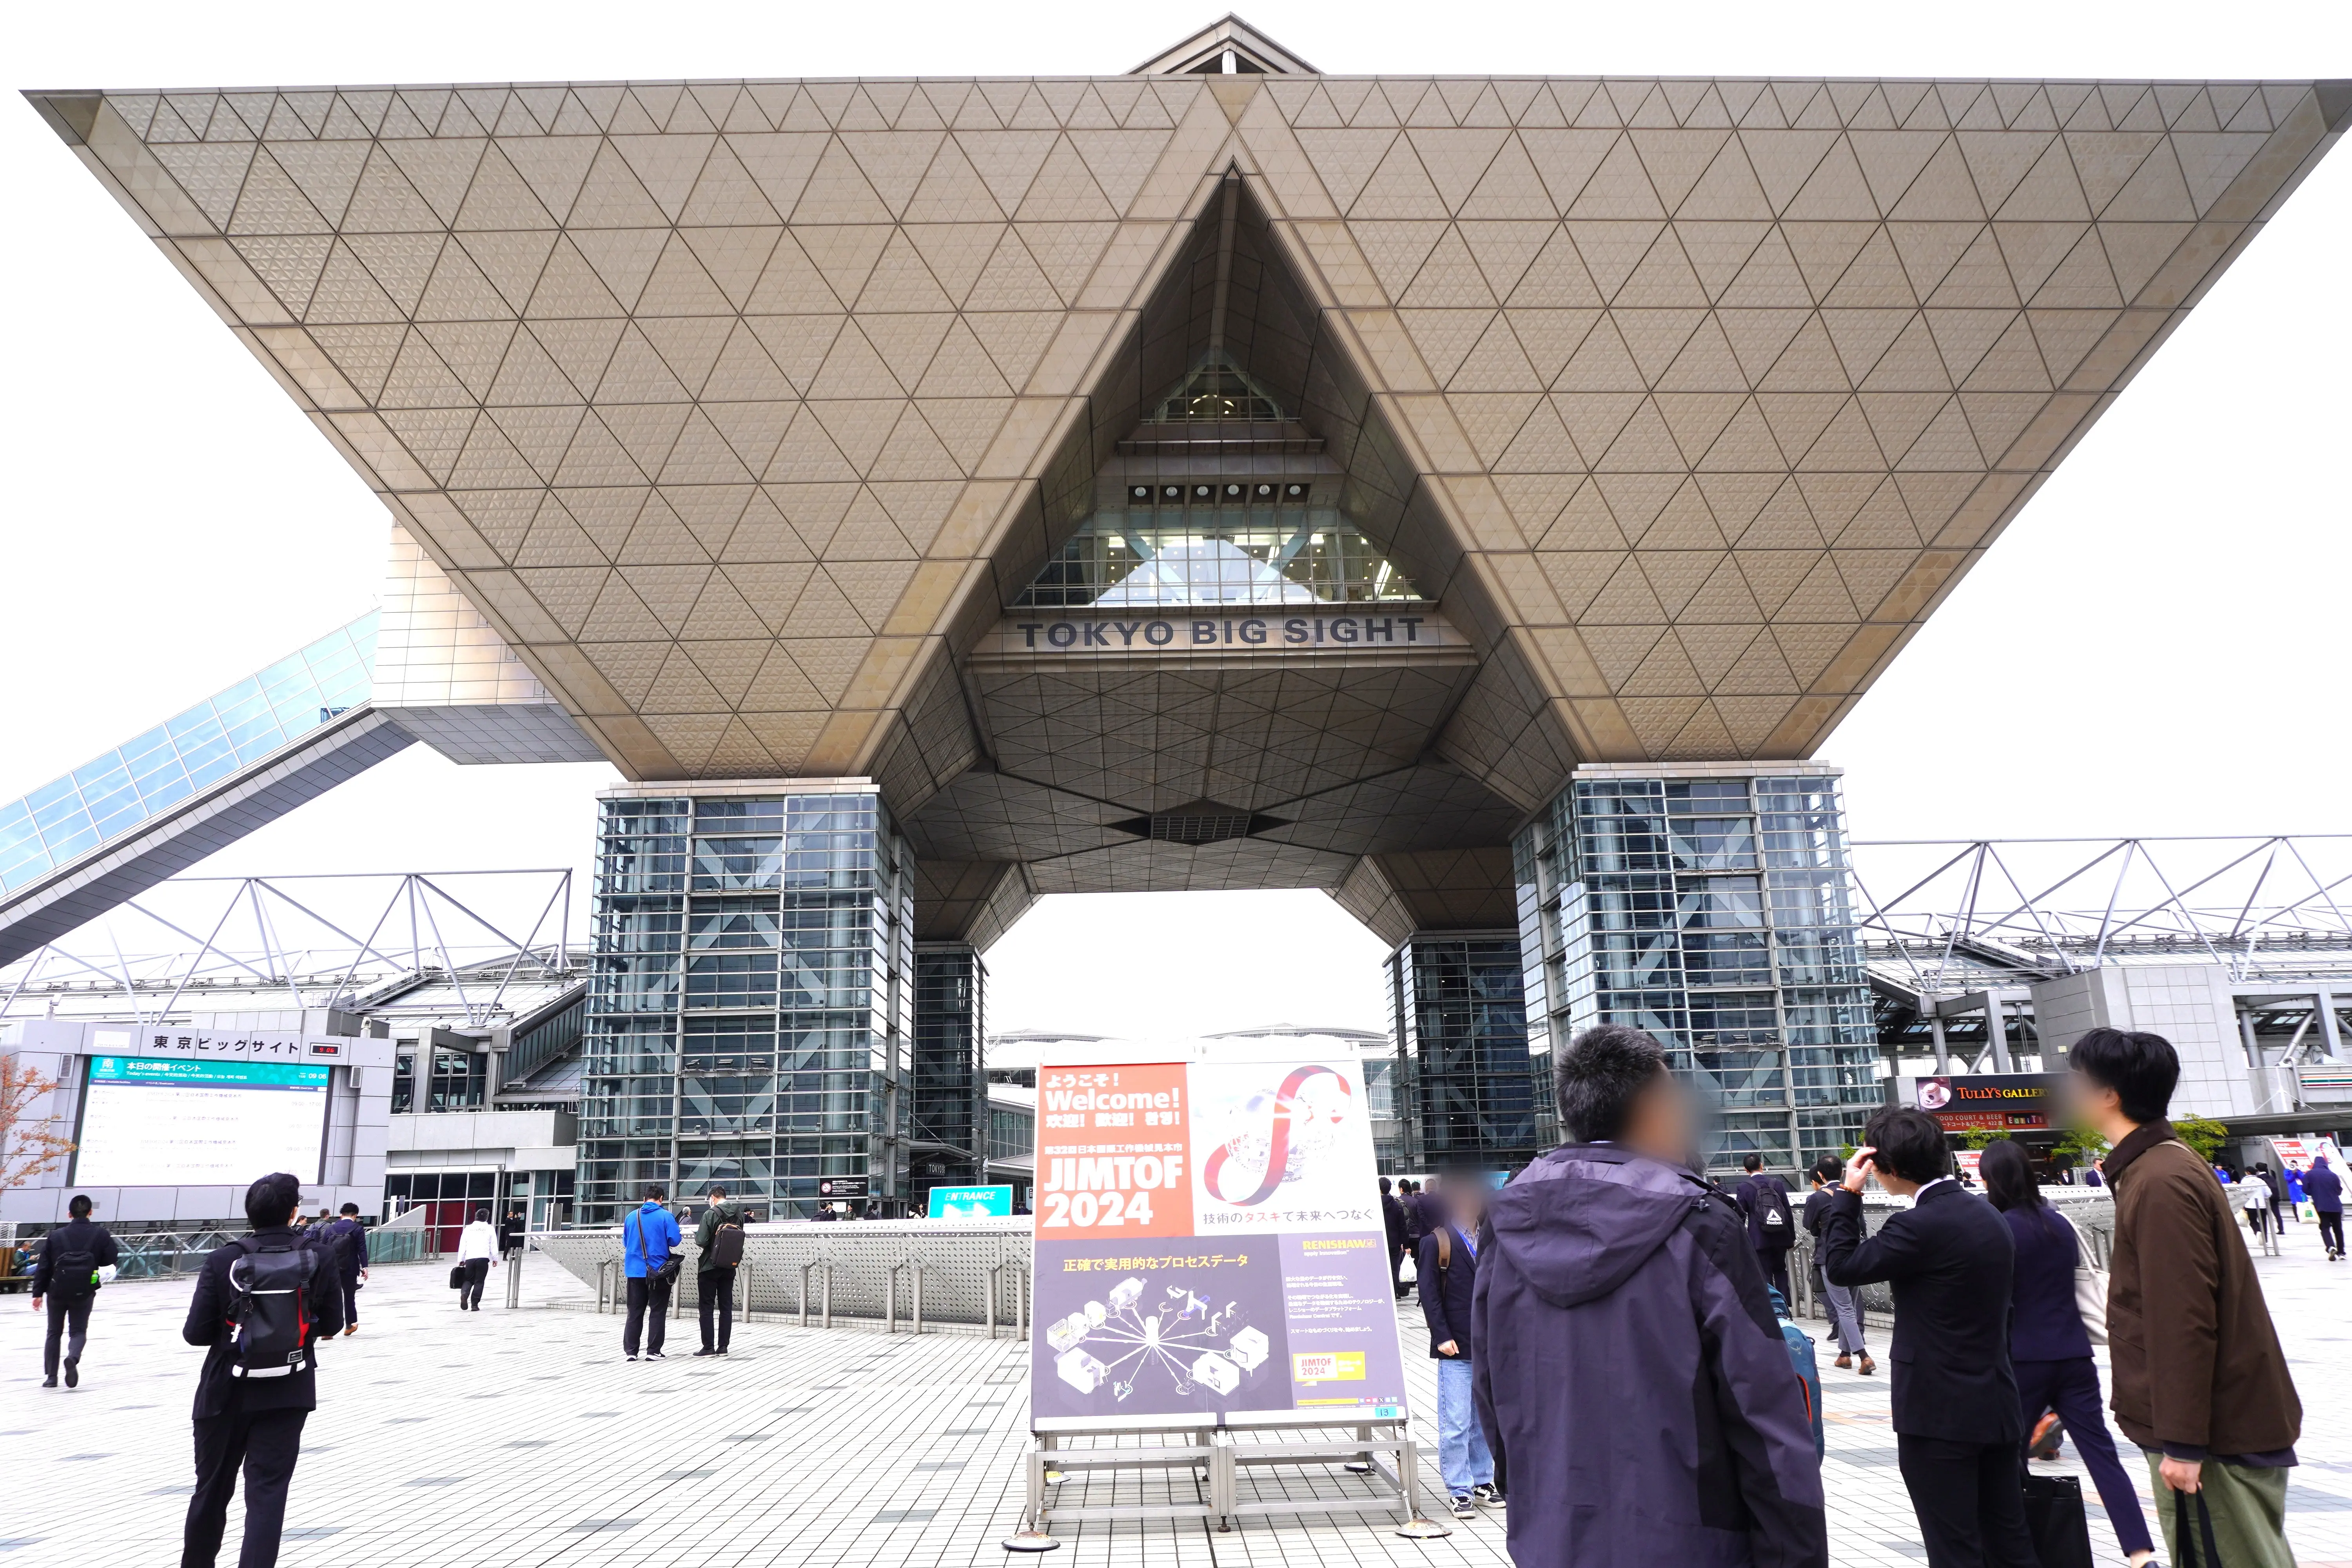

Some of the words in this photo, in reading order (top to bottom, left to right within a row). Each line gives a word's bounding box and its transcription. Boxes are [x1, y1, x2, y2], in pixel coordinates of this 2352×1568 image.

[1017, 621, 1173, 647] TOKYO
[1192, 619, 1267, 644] BIG
[1285, 617, 1424, 643] SIGHT
[153, 1036, 299, 1054] 東京ビッグサイト
[102, 1058, 115, 1069] 南
[127, 1062, 201, 1072] 本日の開催イベント
[1046, 1073, 1119, 1088] ようこそ！
[1045, 1087, 1179, 1111] Welcome!
[2003, 1089, 2051, 1098] GALLERY
[929, 1164, 942, 1173] TOKYO
[1044, 1155, 1183, 1192] JIMTOF
[945, 1191, 996, 1201] ENTRANCE
[1042, 1191, 1153, 1228] 2024
[1203, 1208, 1374, 1225] 技術のタスキで未来へつなぐ
[1063, 1254, 1249, 1272] 正確で実用的なプロセスデータ
[1301, 1358, 1331, 1367] JIMTOF
[1302, 1367, 1325, 1376] 2024
